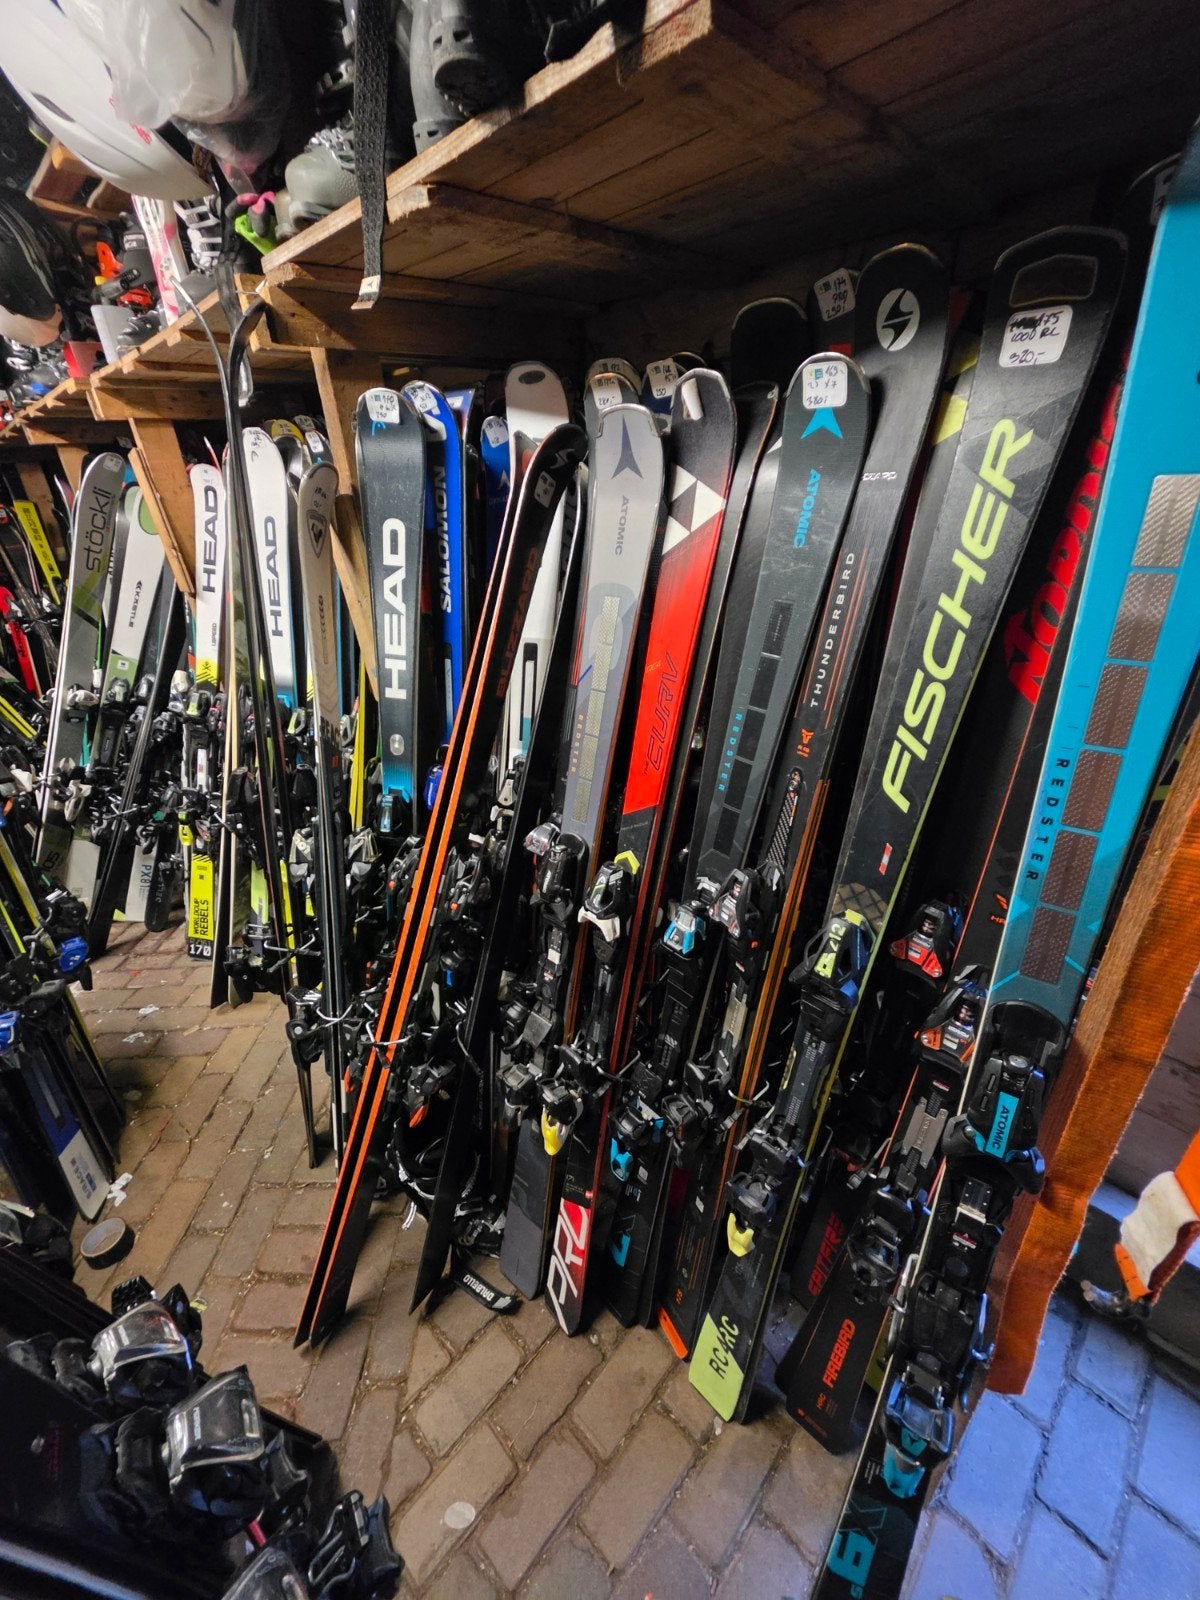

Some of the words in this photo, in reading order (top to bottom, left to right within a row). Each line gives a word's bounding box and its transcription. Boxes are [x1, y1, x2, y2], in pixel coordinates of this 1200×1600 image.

[85, 486, 112, 573] stöckli
[202, 485, 218, 593] HEAD
[433, 465, 452, 614] SALOMON
[614, 495, 629, 556] ATOMIC
[793, 468, 821, 549] ATOMIC
[264, 515, 284, 637] HEAD
[382, 517, 407, 700] HEAD
[882, 418, 1035, 814] FISCHER
[811, 552, 855, 708] THUNDERBIRD
[571, 714, 584, 774] REDSTER
[646, 651, 679, 772] CURV
[718, 712, 744, 793] REDSTER
[1005, 757, 1071, 881] REDSTER
[189, 943, 211, 956] 170
[200, 899, 209, 937] REBELS
[991, 1105, 1011, 1152] ATOMIC
[462, 1273, 495, 1302] DALBELLO
[822, 1317, 857, 1389] FIREBIRD
